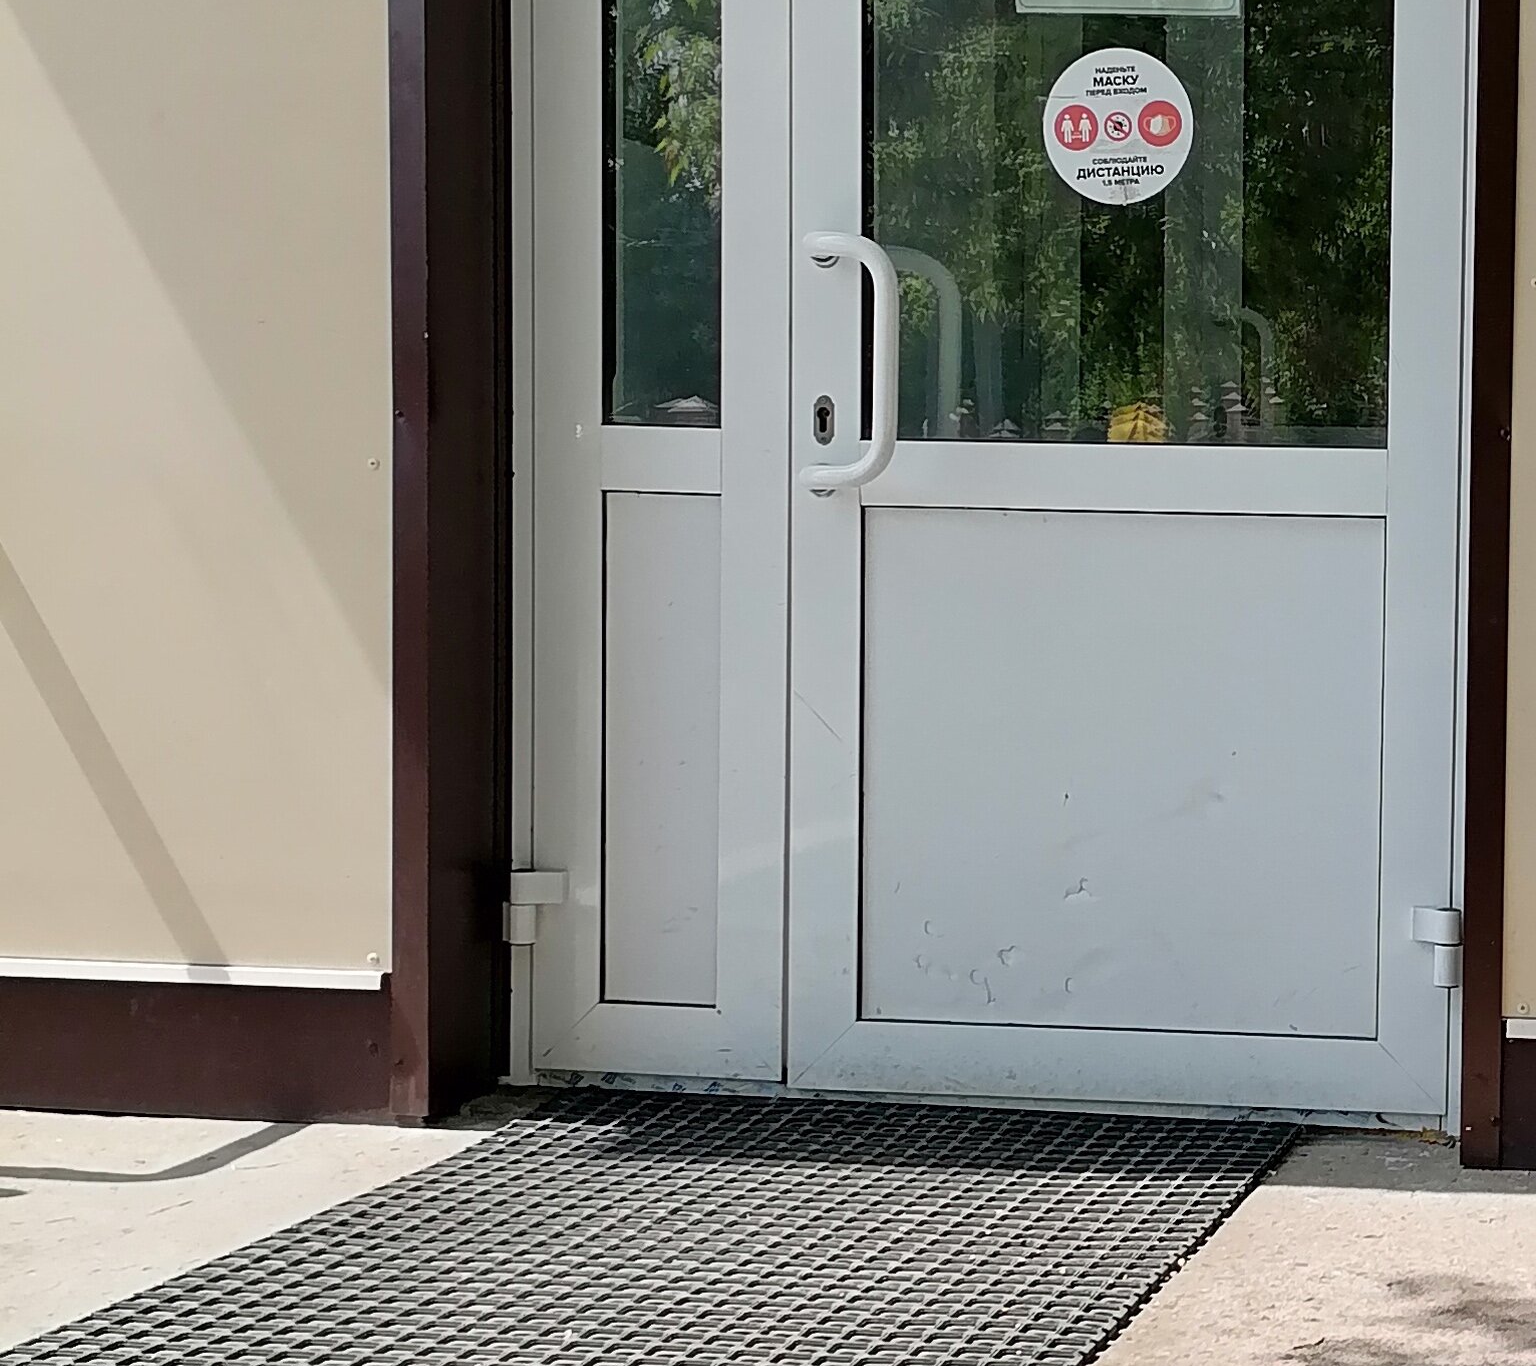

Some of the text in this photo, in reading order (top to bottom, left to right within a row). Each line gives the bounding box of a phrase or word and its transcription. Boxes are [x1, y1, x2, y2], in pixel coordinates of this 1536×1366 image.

[1093, 75, 1139, 87] МАСКУ
[1113, 87, 1147, 95] ВХОДОМ
[1092, 156, 1147, 164] СОБЛЮДАЙТЕ
[1076, 164, 1164, 180] ДИСТАНЦИЮ
